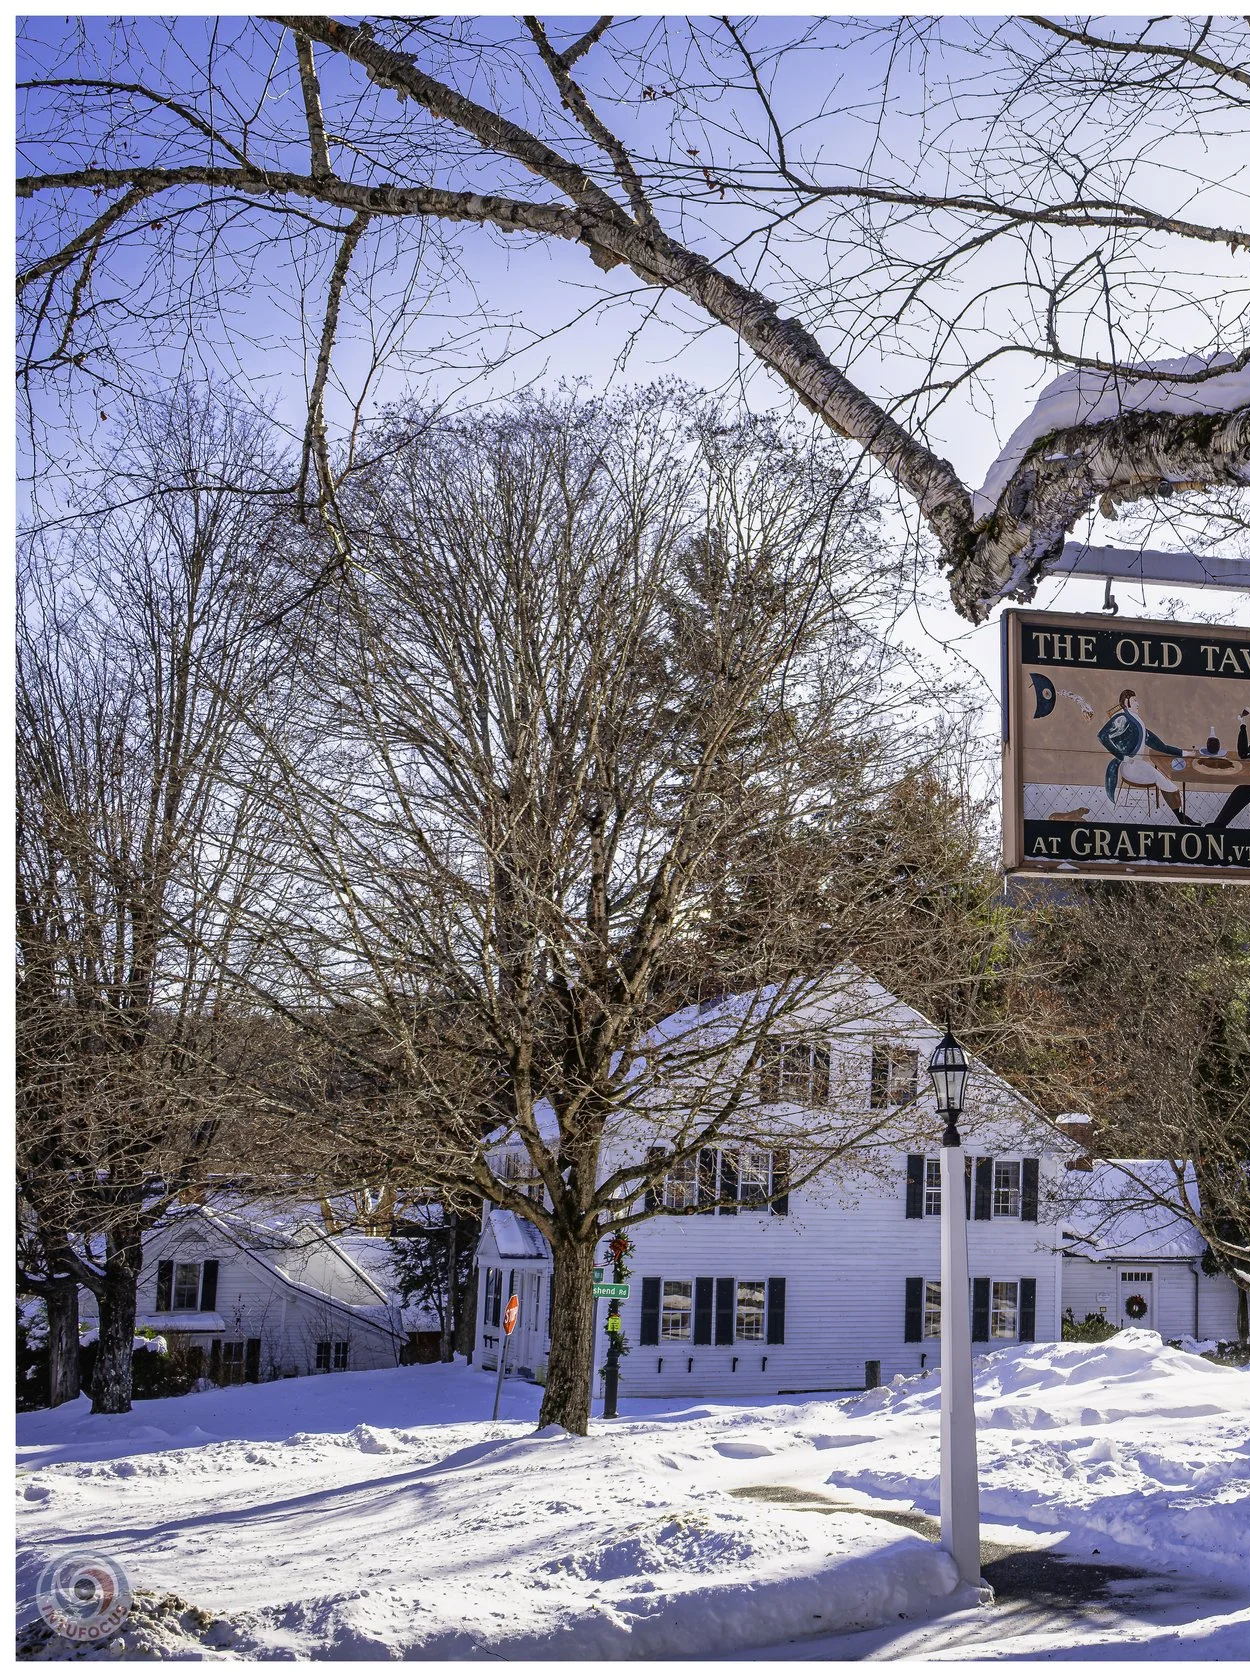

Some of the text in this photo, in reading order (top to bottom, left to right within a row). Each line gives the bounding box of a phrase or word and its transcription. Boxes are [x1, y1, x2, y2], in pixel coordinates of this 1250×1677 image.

[1032, 632, 1097, 663] THE
[1115, 638, 1183, 668] OLD
[1032, 836, 1062, 854] AT
[592, 1286, 616, 1295] shend
